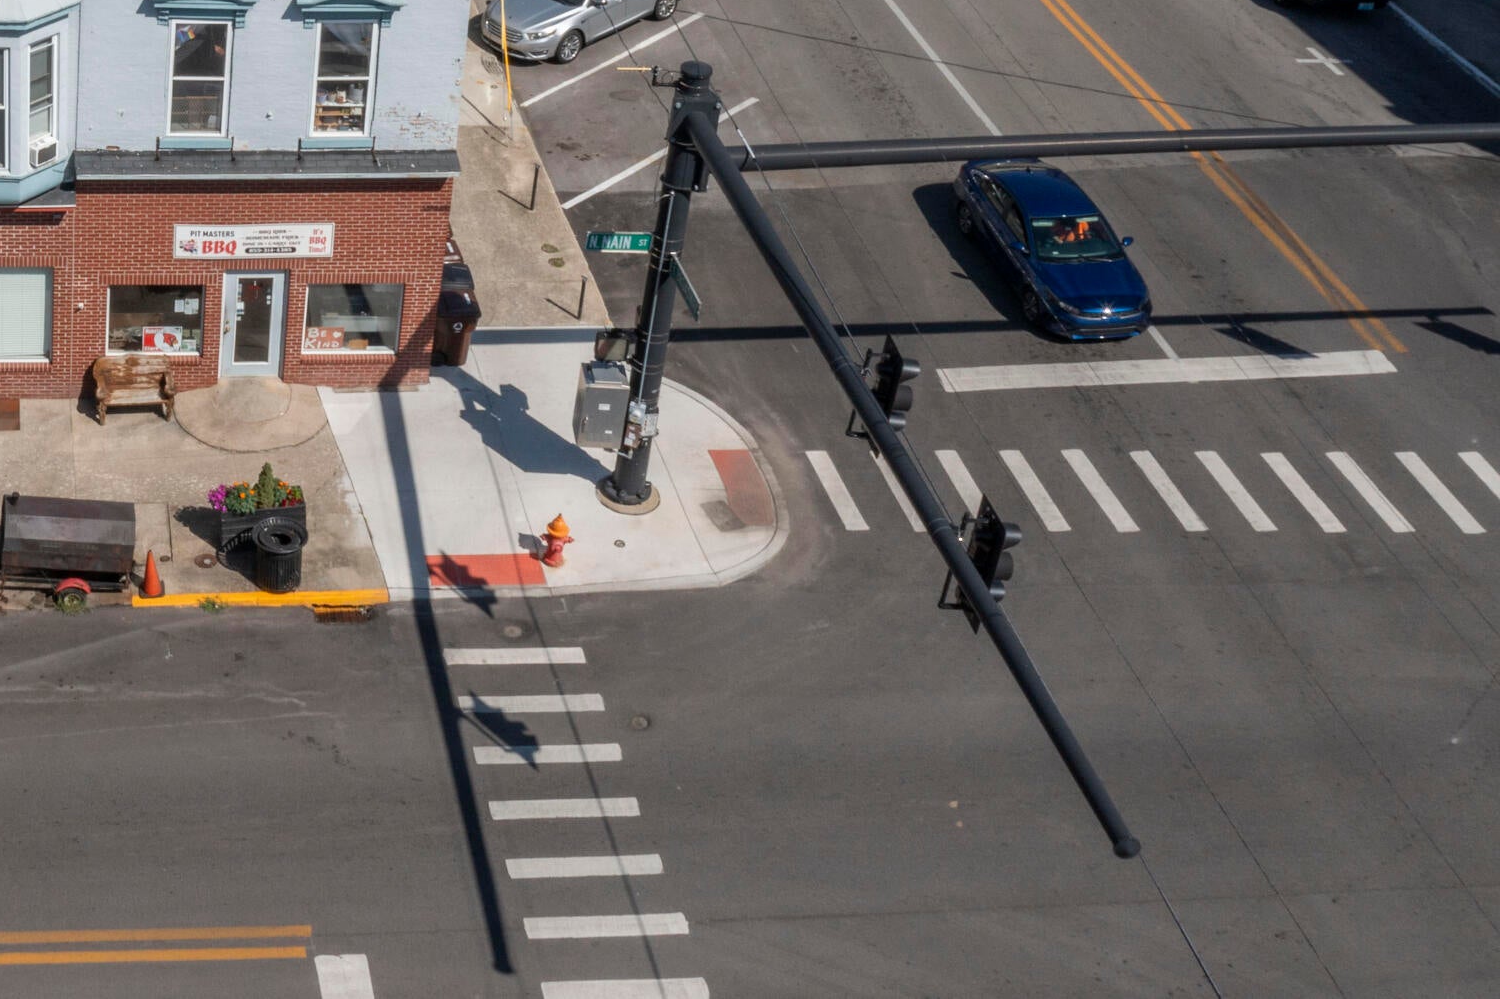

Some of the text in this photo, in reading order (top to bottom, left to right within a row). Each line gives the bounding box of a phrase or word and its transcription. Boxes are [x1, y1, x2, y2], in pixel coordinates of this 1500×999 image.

[202, 230, 235, 238] MASTERS
[309, 236, 327, 245] BBQ
[601, 235, 632, 250] MAIN
[637, 239, 648, 247] ST
[202, 240, 237, 255] BBQ
